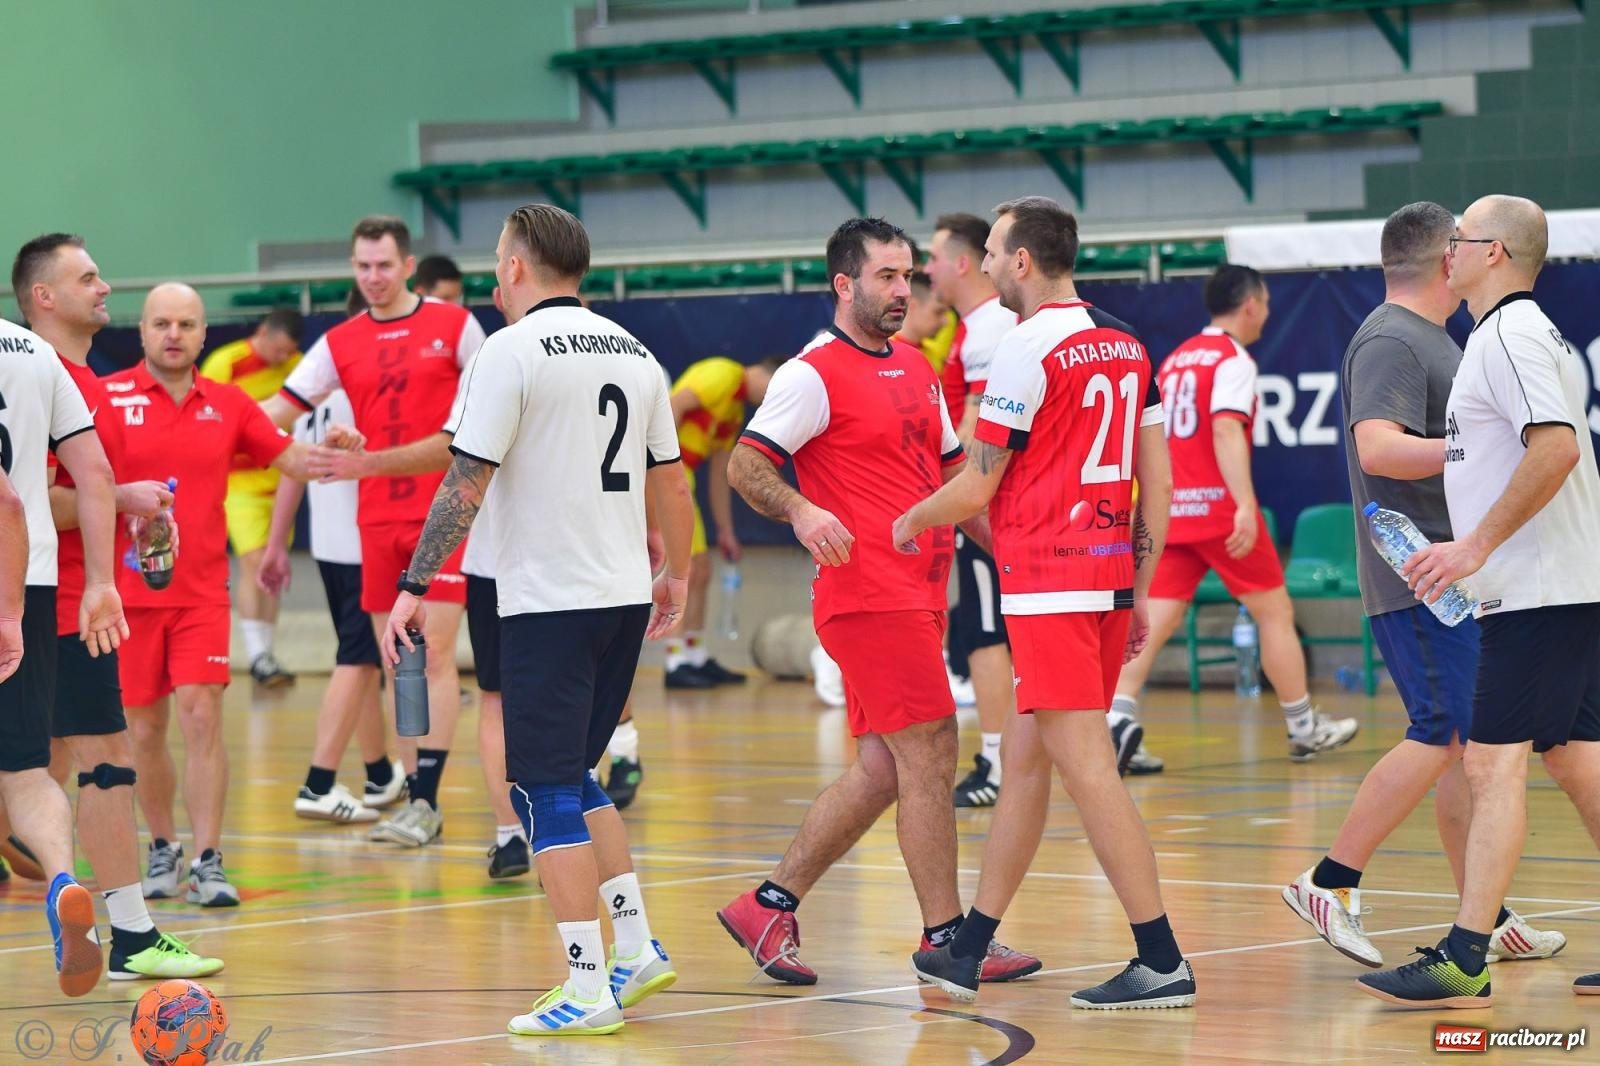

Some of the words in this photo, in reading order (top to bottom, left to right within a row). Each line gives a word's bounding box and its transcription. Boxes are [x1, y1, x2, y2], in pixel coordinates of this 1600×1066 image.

[0, 337, 35, 354] WAC
[540, 335, 567, 356] KS
[567, 334, 647, 359] KORNOWAC
[877, 368, 905, 378] regio
[125, 405, 145, 426] KJ
[1162, 368, 1199, 440] 18
[598, 382, 630, 493] 2
[1081, 371, 1138, 486] 21
[567, 960, 597, 971] OTTO
